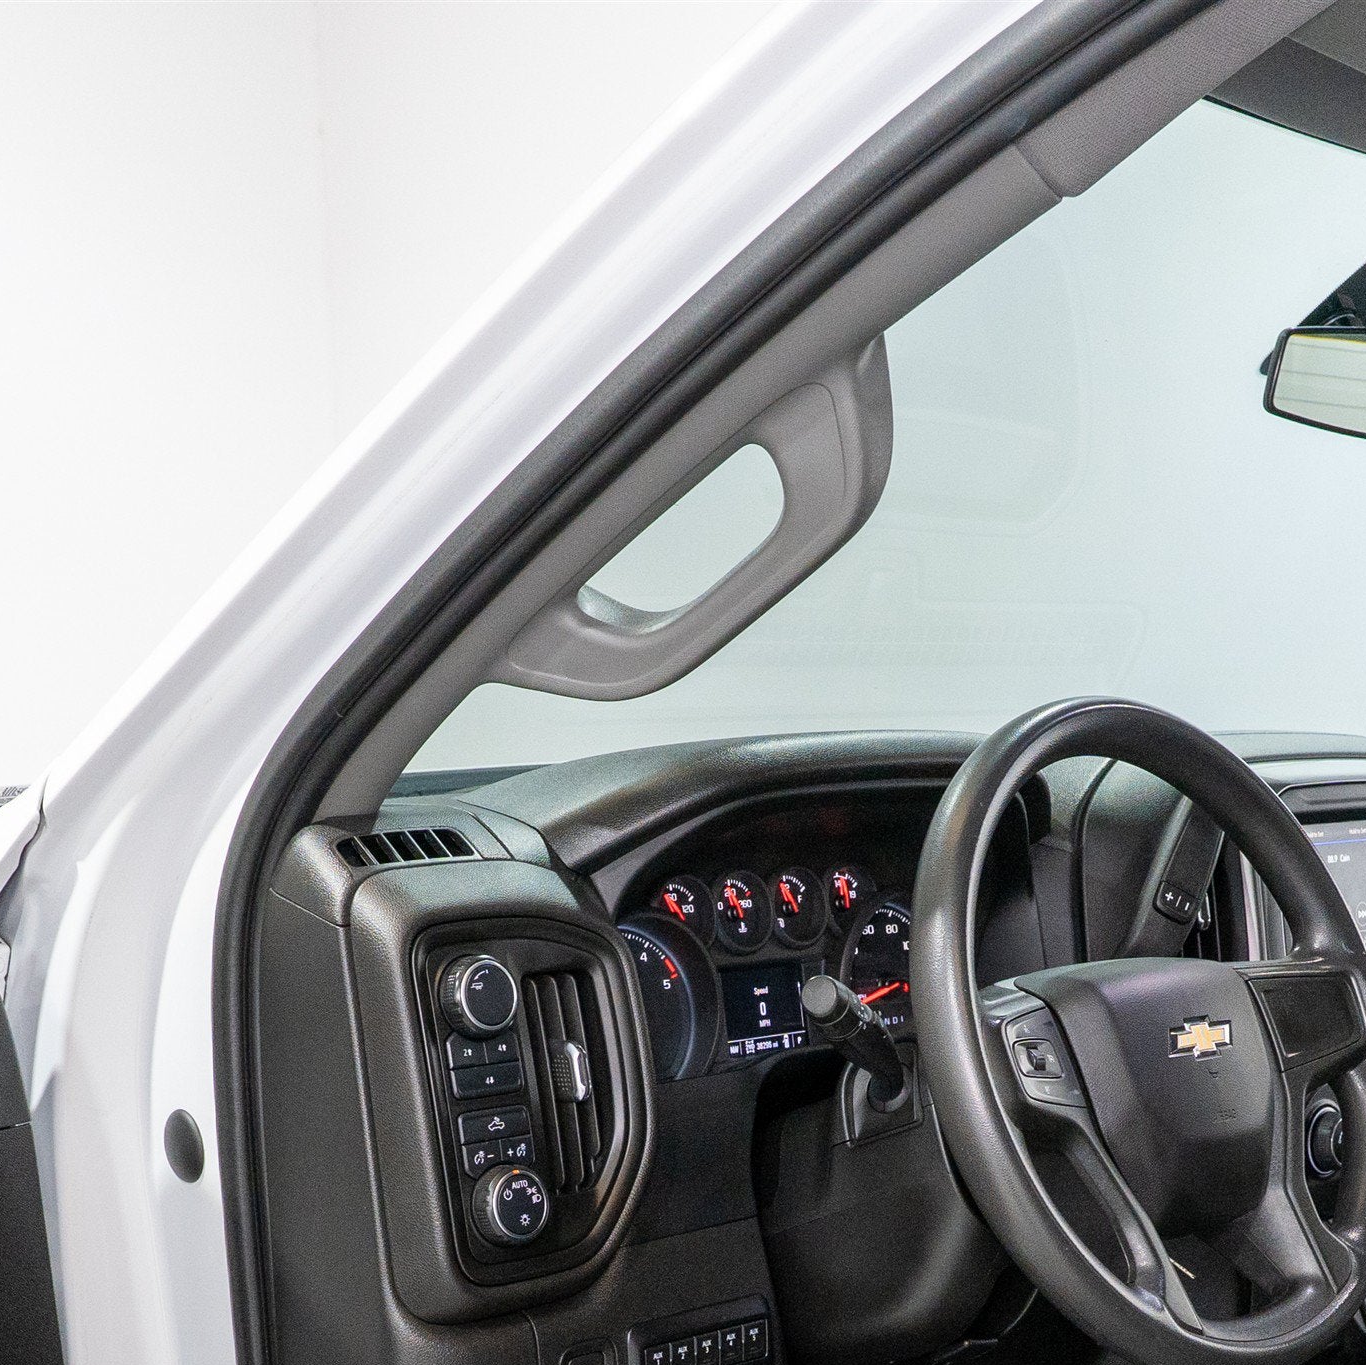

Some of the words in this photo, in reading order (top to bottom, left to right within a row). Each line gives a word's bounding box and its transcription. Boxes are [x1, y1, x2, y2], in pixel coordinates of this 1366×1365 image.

[681, 904, 694, 913] 120
[886, 924, 898, 934] 80
[640, 952, 648, 962] 4
[663, 979, 671, 990] 5
[753, 985, 769, 996] Speed
[759, 1002, 767, 1016] 0
[759, 1019, 771, 1028] MPH
[511, 1180, 529, 1190] AUTO
[749, 1327, 759, 1336] AUX
[726, 1333, 736, 1341] AUX
[702, 1339, 712, 1348] AUX
[678, 1346, 688, 1354] AUX
[653, 1352, 663, 1360] AUX
